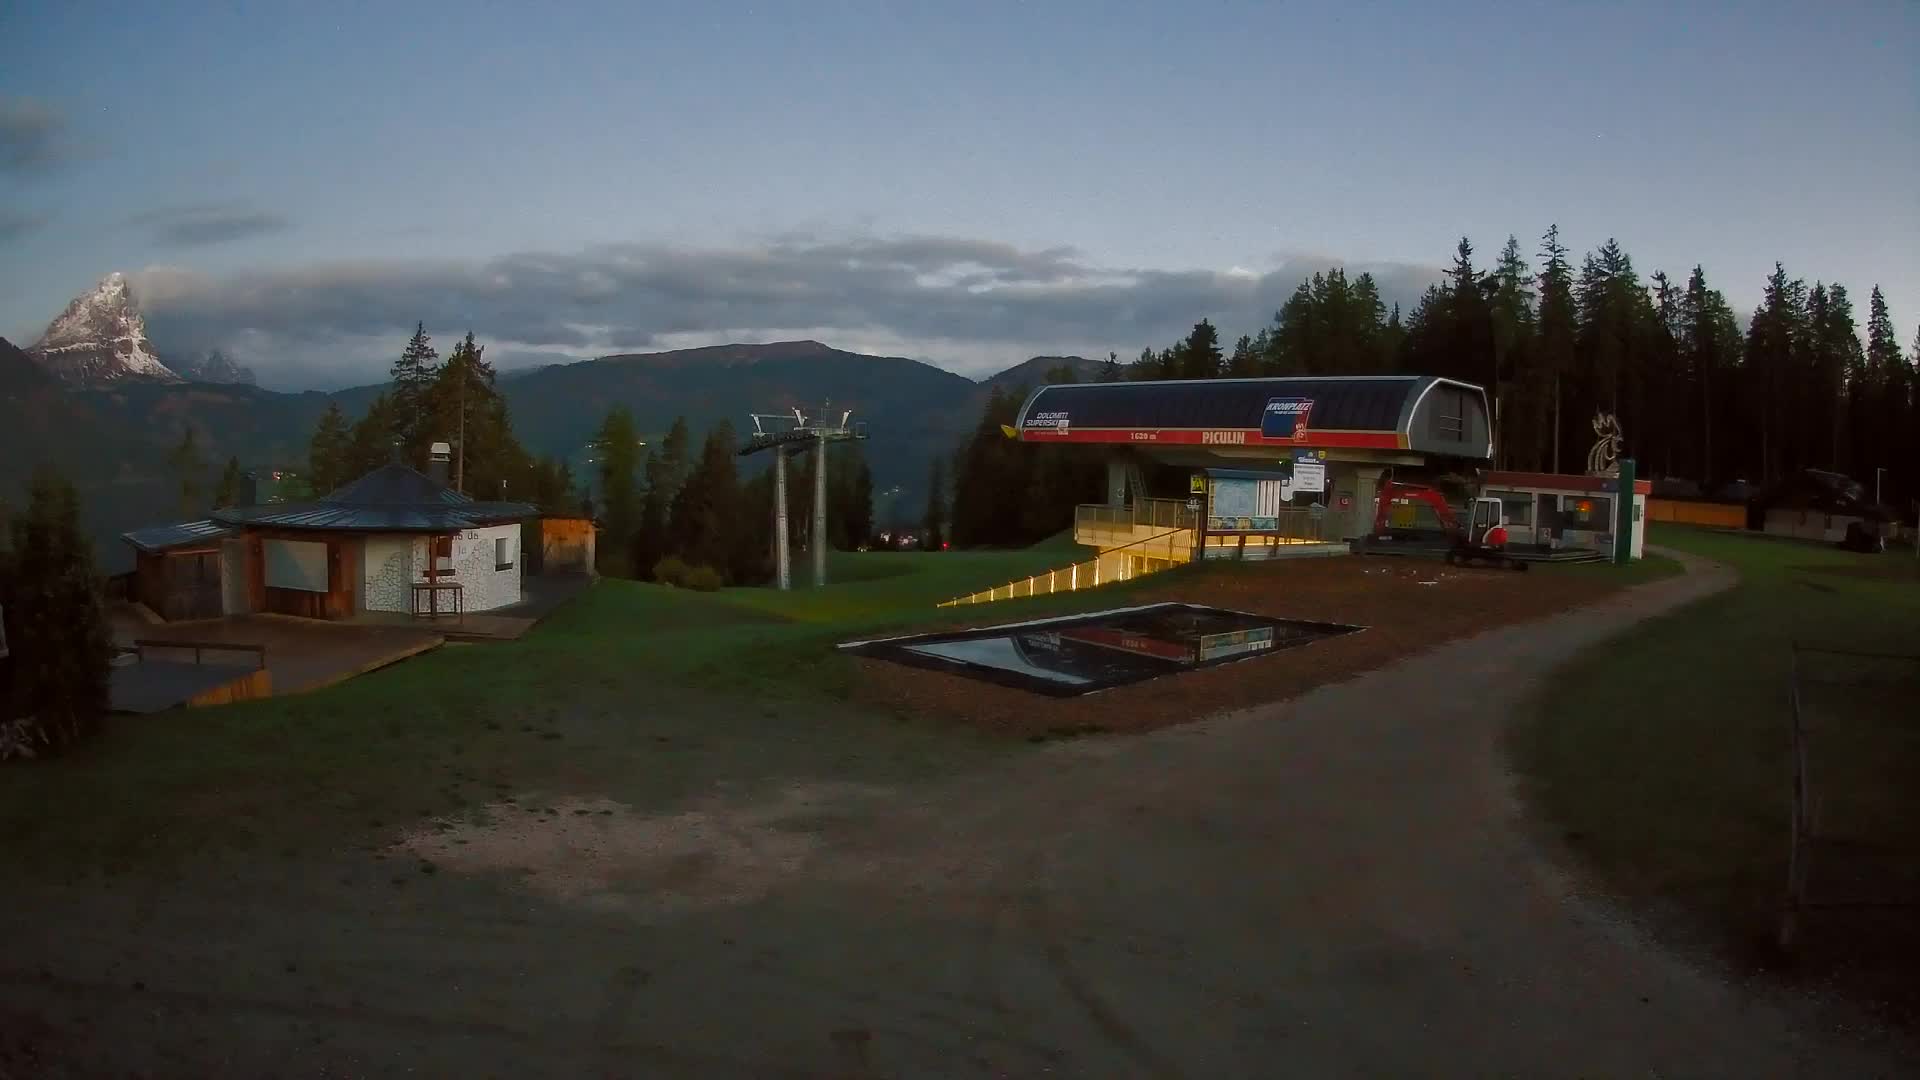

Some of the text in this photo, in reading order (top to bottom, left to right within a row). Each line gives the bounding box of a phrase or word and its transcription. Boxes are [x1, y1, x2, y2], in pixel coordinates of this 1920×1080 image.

[1266, 402, 1313, 411] KRONPLATZ
[1025, 419, 1059, 427] SUPERSKI
[1202, 431, 1245, 444] PICULIN
